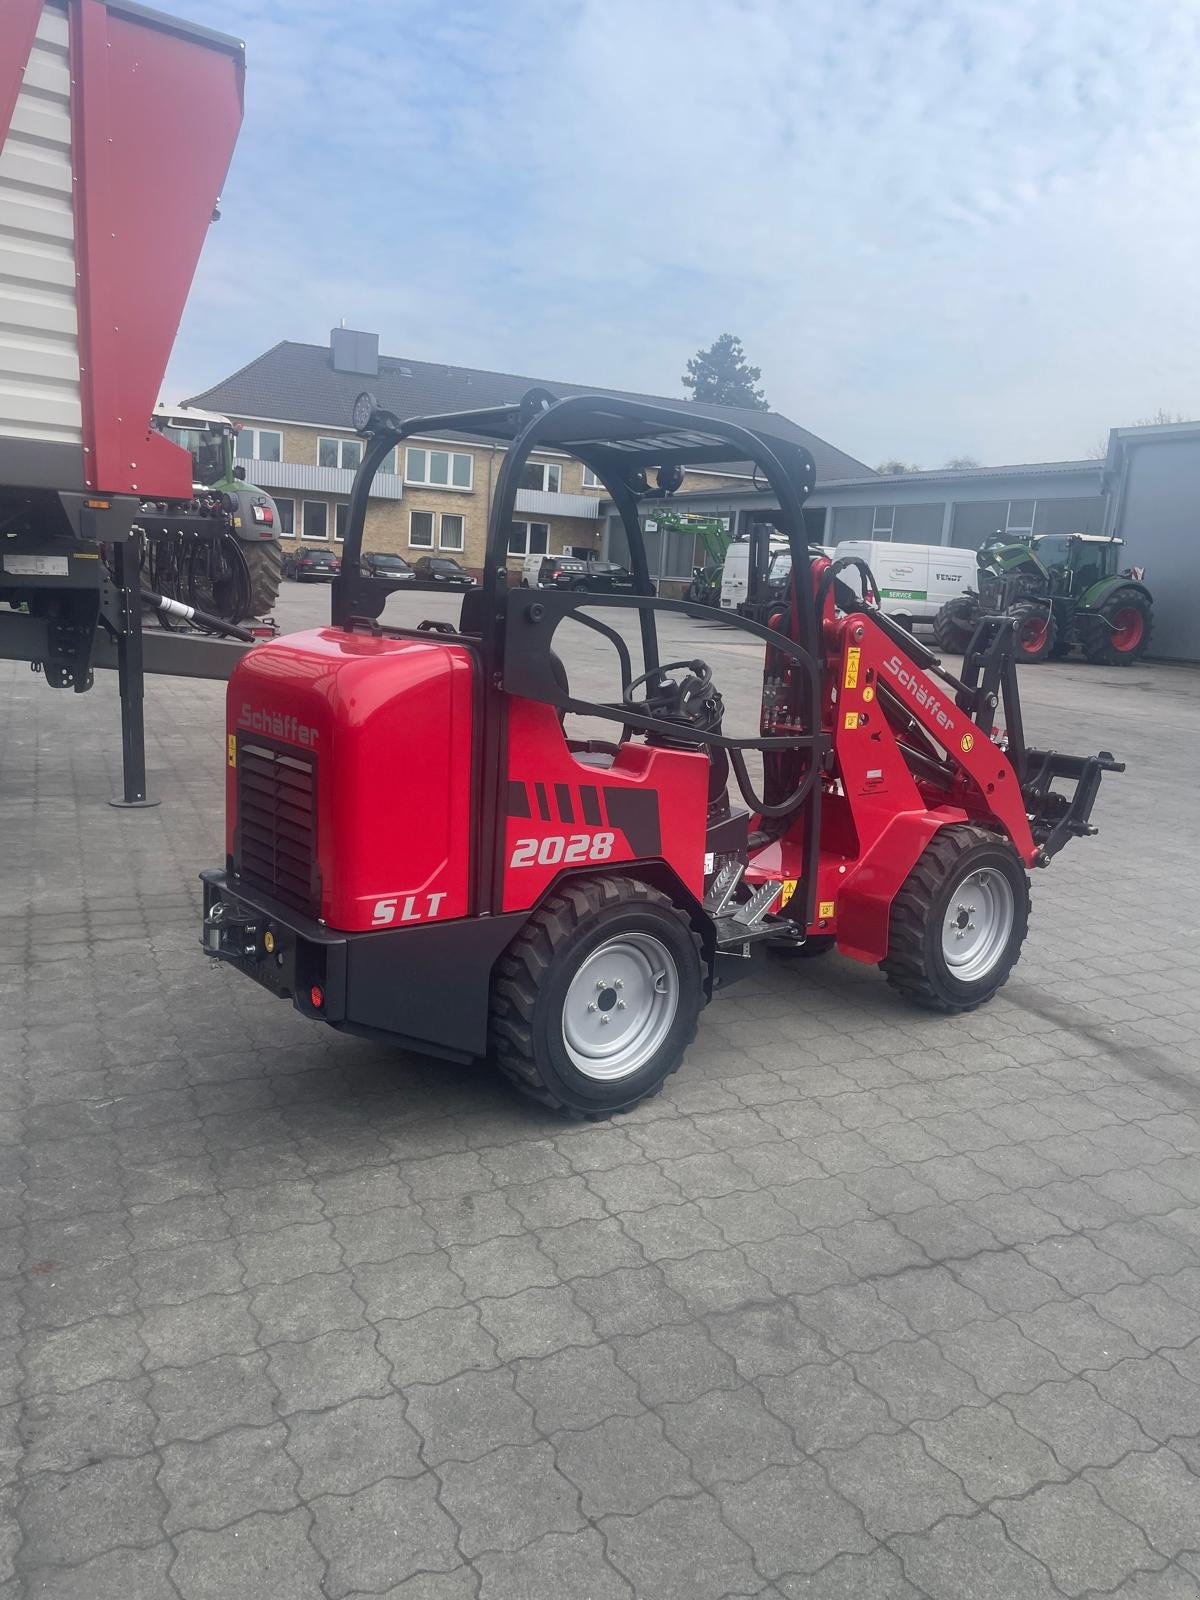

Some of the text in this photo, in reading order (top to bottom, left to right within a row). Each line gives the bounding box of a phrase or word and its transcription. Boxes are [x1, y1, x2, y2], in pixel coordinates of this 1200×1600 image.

[888, 591, 912, 599] SERVICE
[935, 573, 962, 582] FENDT
[882, 655, 955, 731] Schäffer
[238, 703, 319, 746] Schäffer
[510, 832, 615, 868] 2028
[371, 892, 447, 926] SLT
